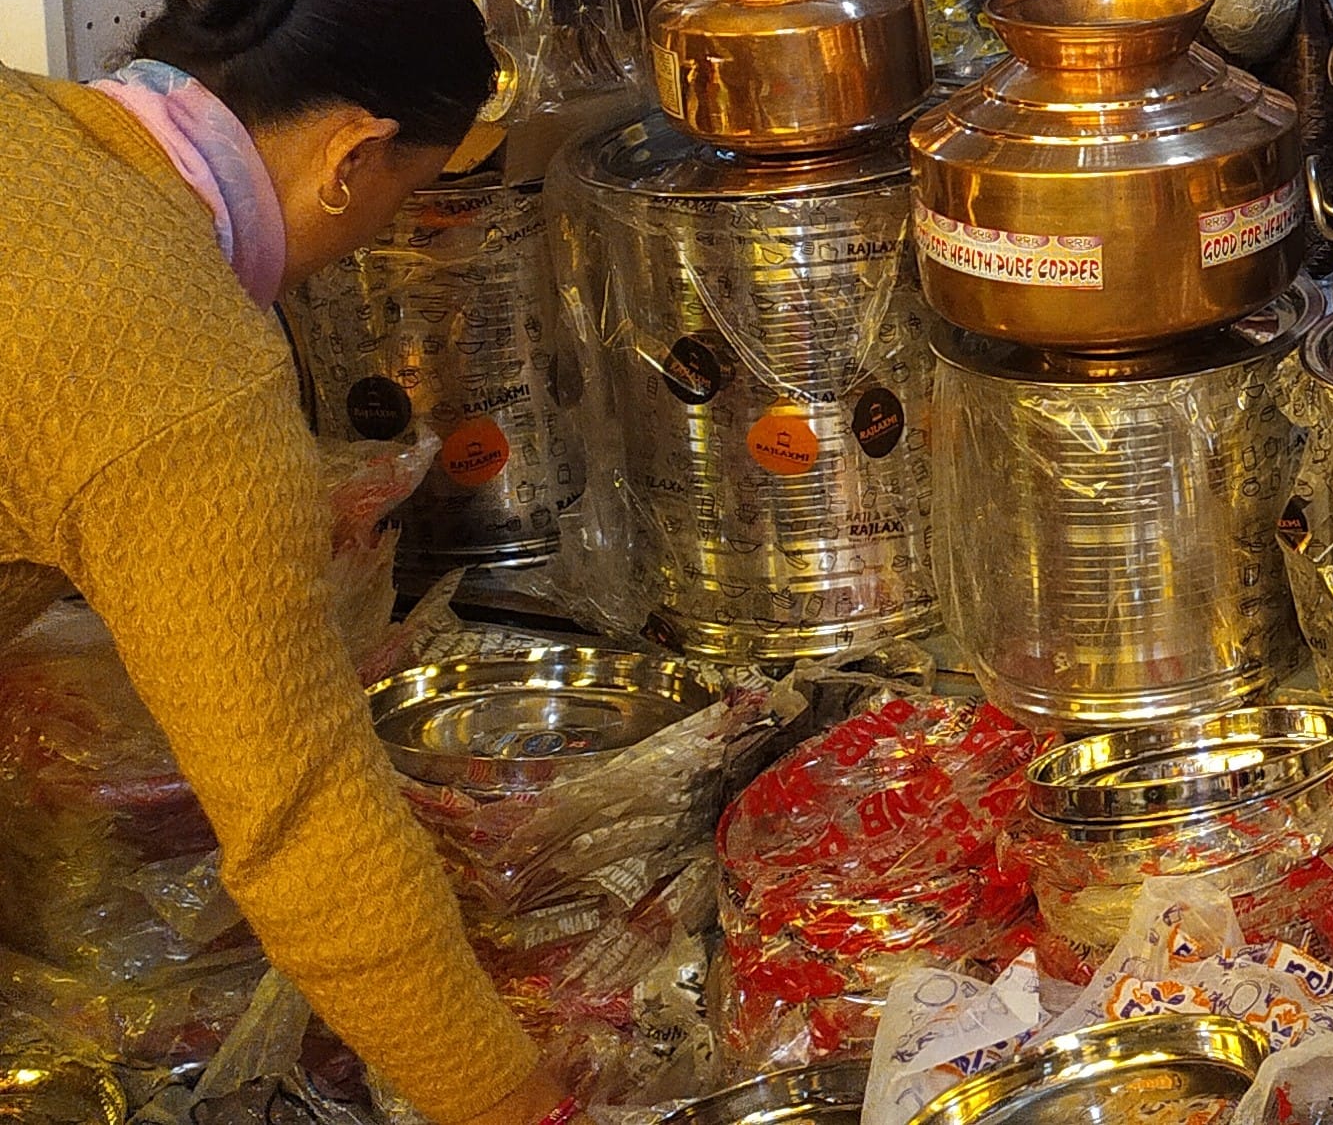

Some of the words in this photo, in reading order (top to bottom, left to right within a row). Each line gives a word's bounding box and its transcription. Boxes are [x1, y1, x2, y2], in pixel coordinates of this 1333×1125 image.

[847, 240, 905, 257] RAJLAX
[1203, 237, 1237, 261] GOOD
[1241, 226, 1262, 251] FOR
[949, 246, 992, 273] HEALTH
[996, 252, 1033, 282] PURE
[1038, 258, 1100, 282] COPPER
[462, 383, 530, 415] RAJLAXMI
[788, 388, 837, 404] RAJLAX
[859, 415, 899, 440] RAJLAXMI
[450, 450, 503, 471] RAJLAXMI
[756, 442, 810, 463] RAJLAXMI
[849, 521, 905, 536] RAJLAX
